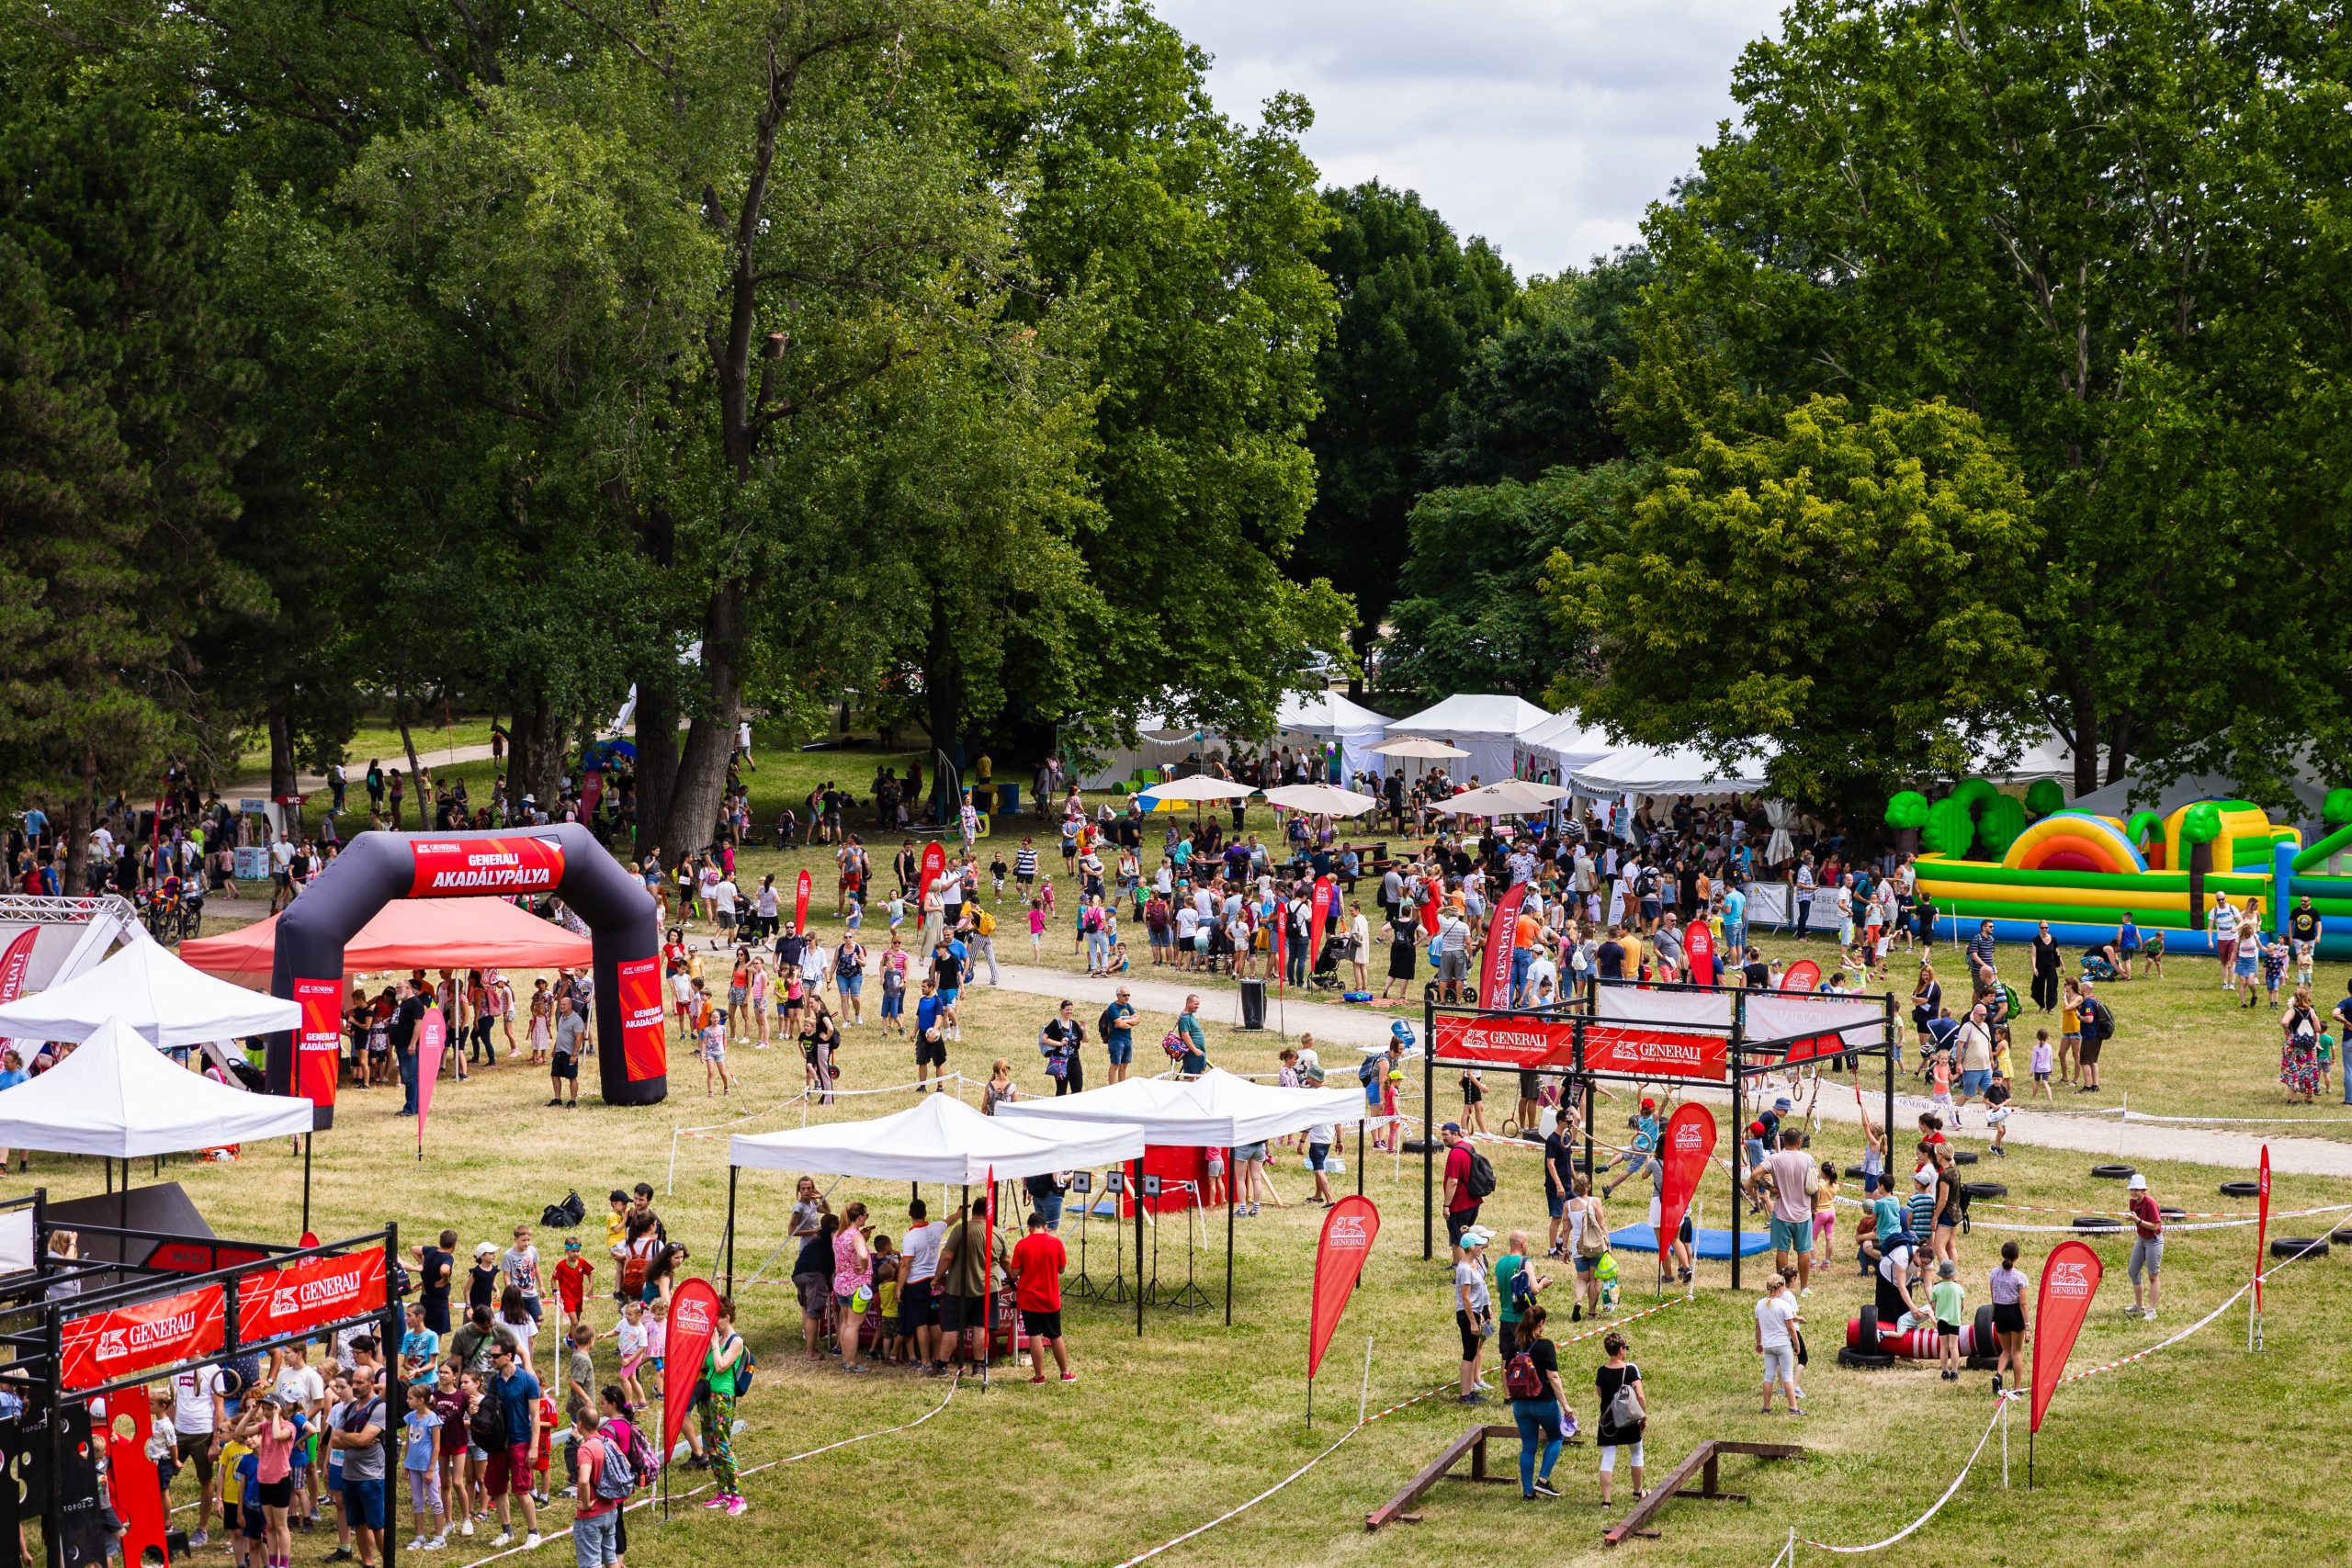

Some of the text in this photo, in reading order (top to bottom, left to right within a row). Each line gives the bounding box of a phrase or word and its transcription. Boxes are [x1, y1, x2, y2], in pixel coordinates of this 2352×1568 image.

[468, 853, 519, 866] GENERALI
[432, 865, 549, 887] AKADÁLYPÁLYA
[1496, 907, 1515, 980] GENERALI
[1490, 1031, 1548, 1046] GENERALI
[1640, 1043, 1702, 1060] GENERALI
[300, 1270, 361, 1303] GENERALI
[2051, 1286, 2088, 1295] GENERALI
[130, 1311, 196, 1345] GENERALI
[677, 1321, 709, 1332] GENERALI
